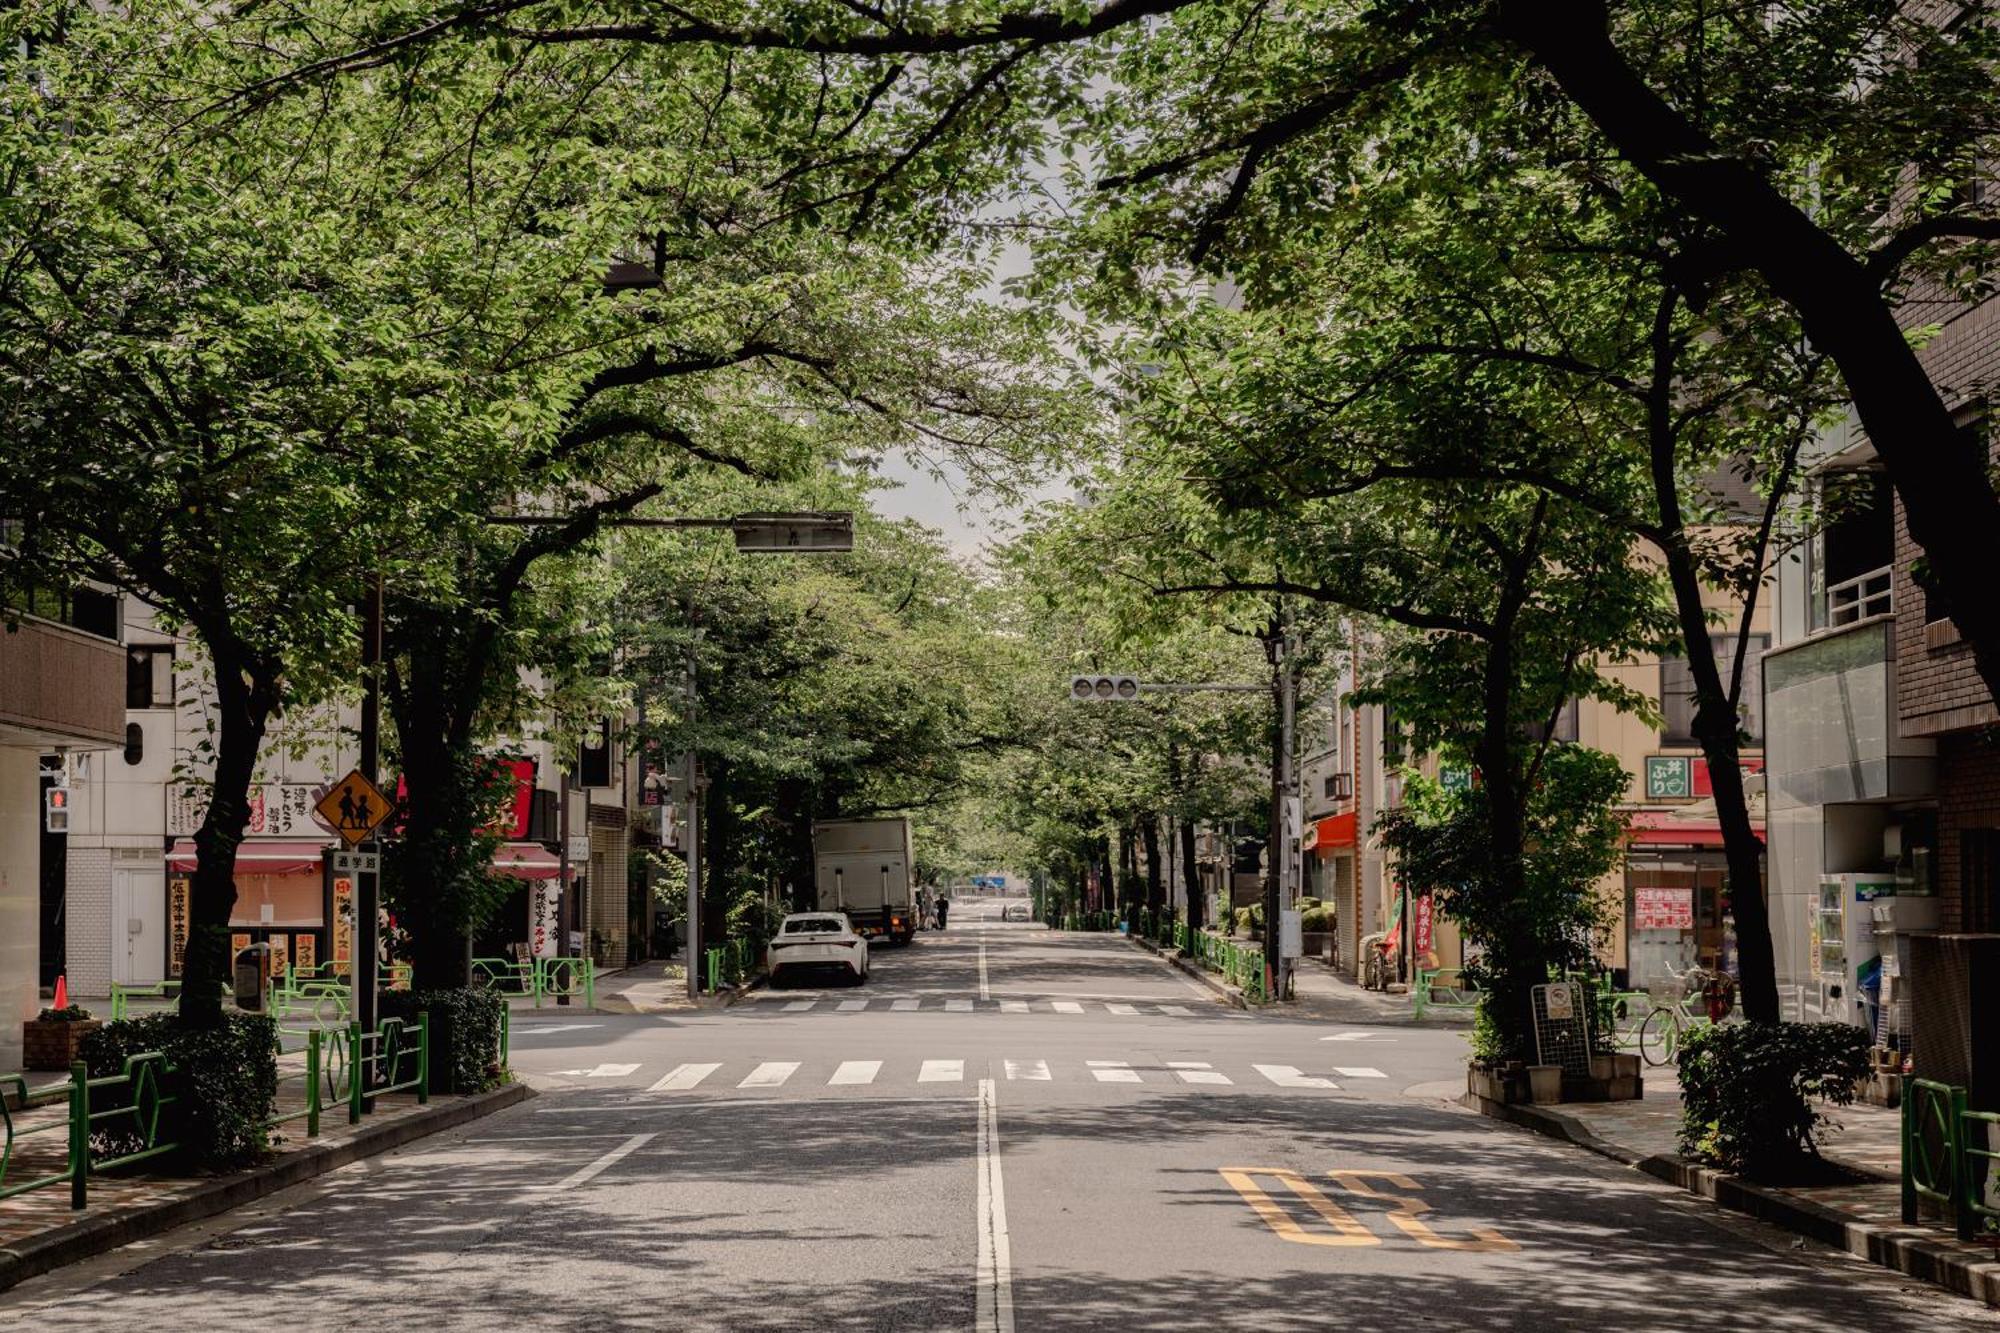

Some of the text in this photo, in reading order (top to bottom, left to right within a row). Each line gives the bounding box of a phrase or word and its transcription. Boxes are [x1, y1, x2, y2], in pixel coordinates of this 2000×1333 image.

[1811, 569, 1824, 595] 2F
[280, 788, 292, 832] とんこつ
[338, 855, 376, 869] 通学路
